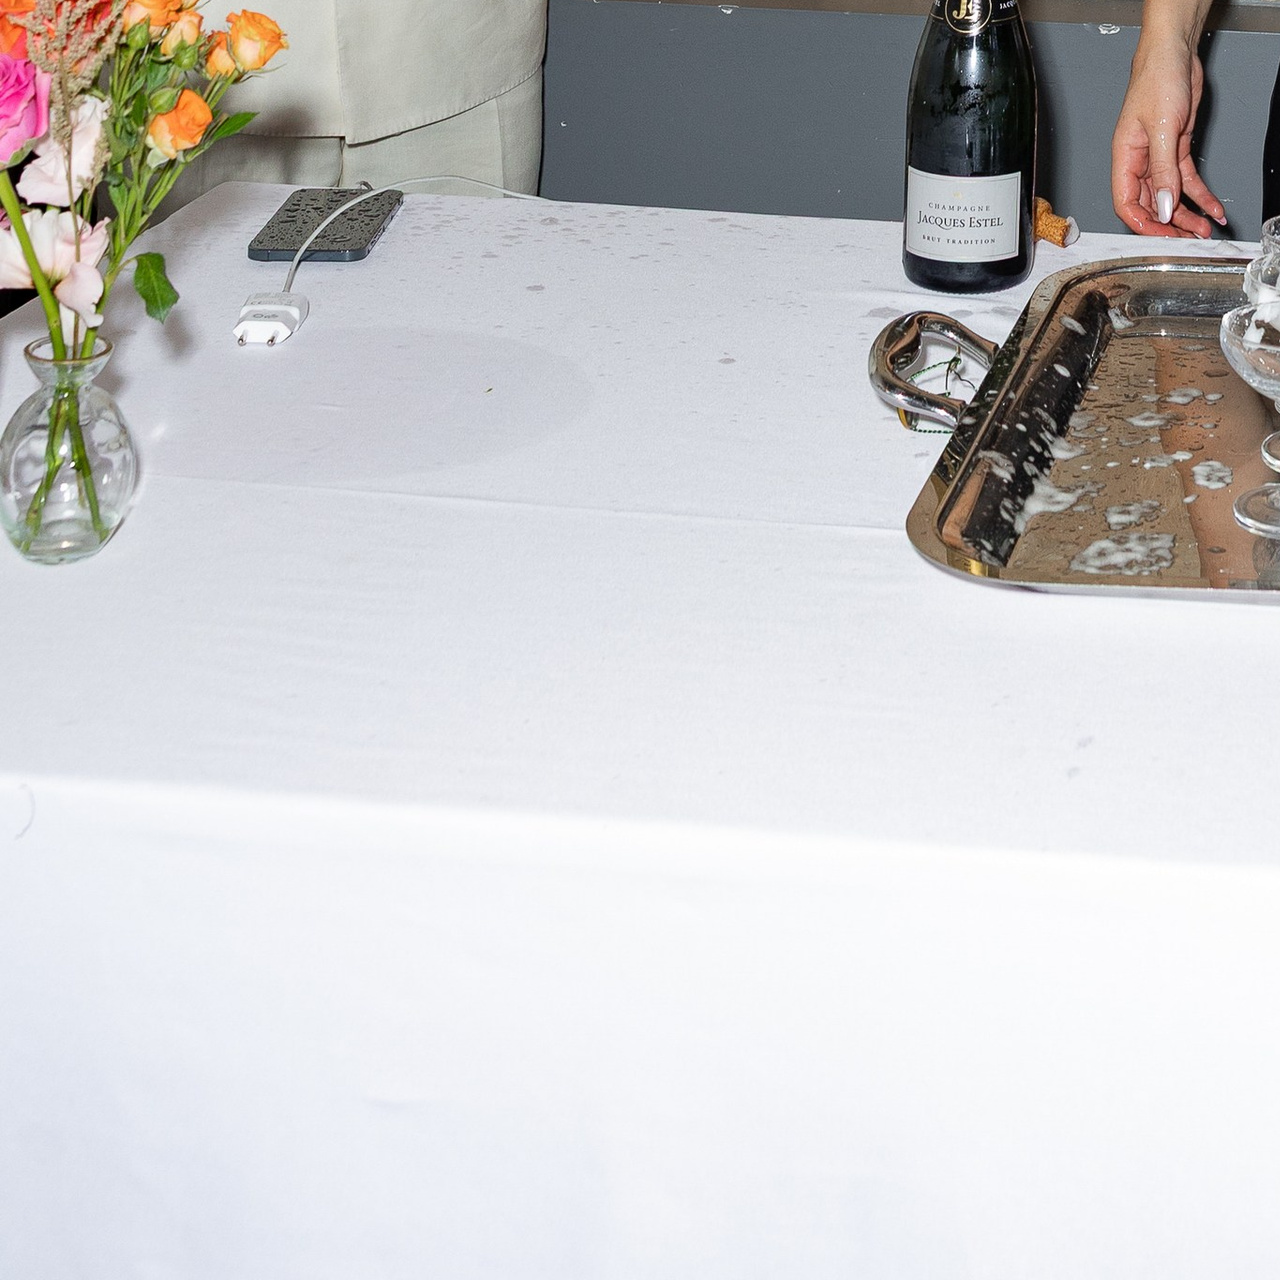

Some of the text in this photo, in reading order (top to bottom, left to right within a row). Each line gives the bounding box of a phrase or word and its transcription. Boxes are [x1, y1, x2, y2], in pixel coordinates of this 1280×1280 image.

[928, 202, 991, 212] CHAMPAGNE
[917, 210, 1004, 230] JACQUES ESTEL
[922, 234, 942, 243] BRUT
